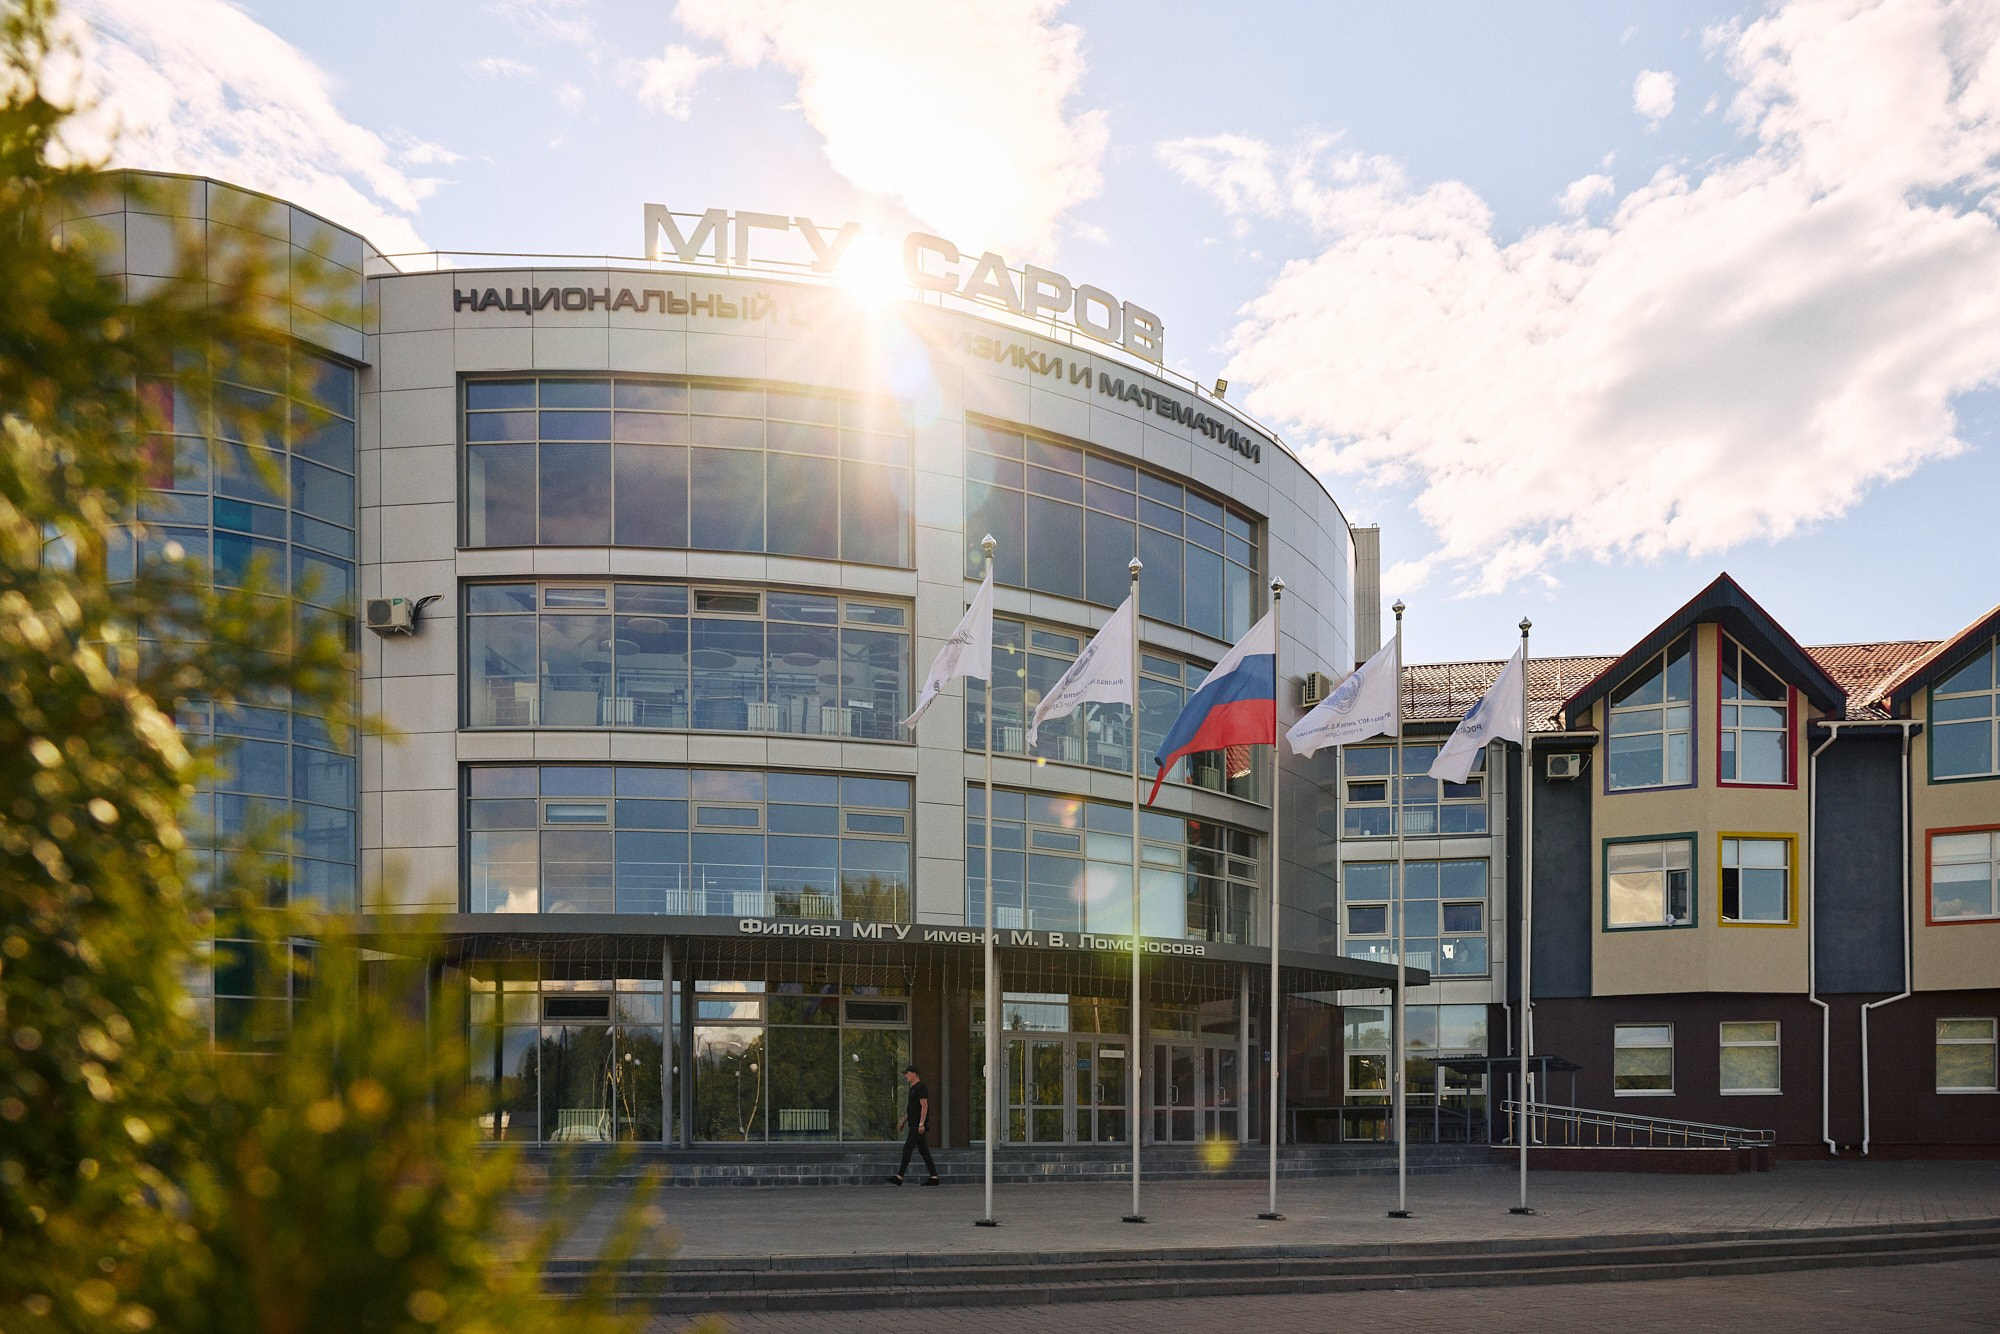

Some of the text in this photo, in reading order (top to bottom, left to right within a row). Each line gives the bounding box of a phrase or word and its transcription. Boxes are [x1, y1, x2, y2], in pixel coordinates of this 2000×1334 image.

[644, 202, 1163, 364] МГУ САРОВ
[453, 287, 777, 324] НАЦИОНАЛЬНЫЙ
[924, 317, 1063, 380] ИЗИКИ
[1071, 362, 1092, 389] И
[1099, 372, 1261, 464] МАТЕМАТИКИ
[739, 918, 841, 937] Филиал
[852, 922, 912, 940] МГУ
[1011, 930, 1039, 947] М.
[1048, 932, 1070, 948] В.
